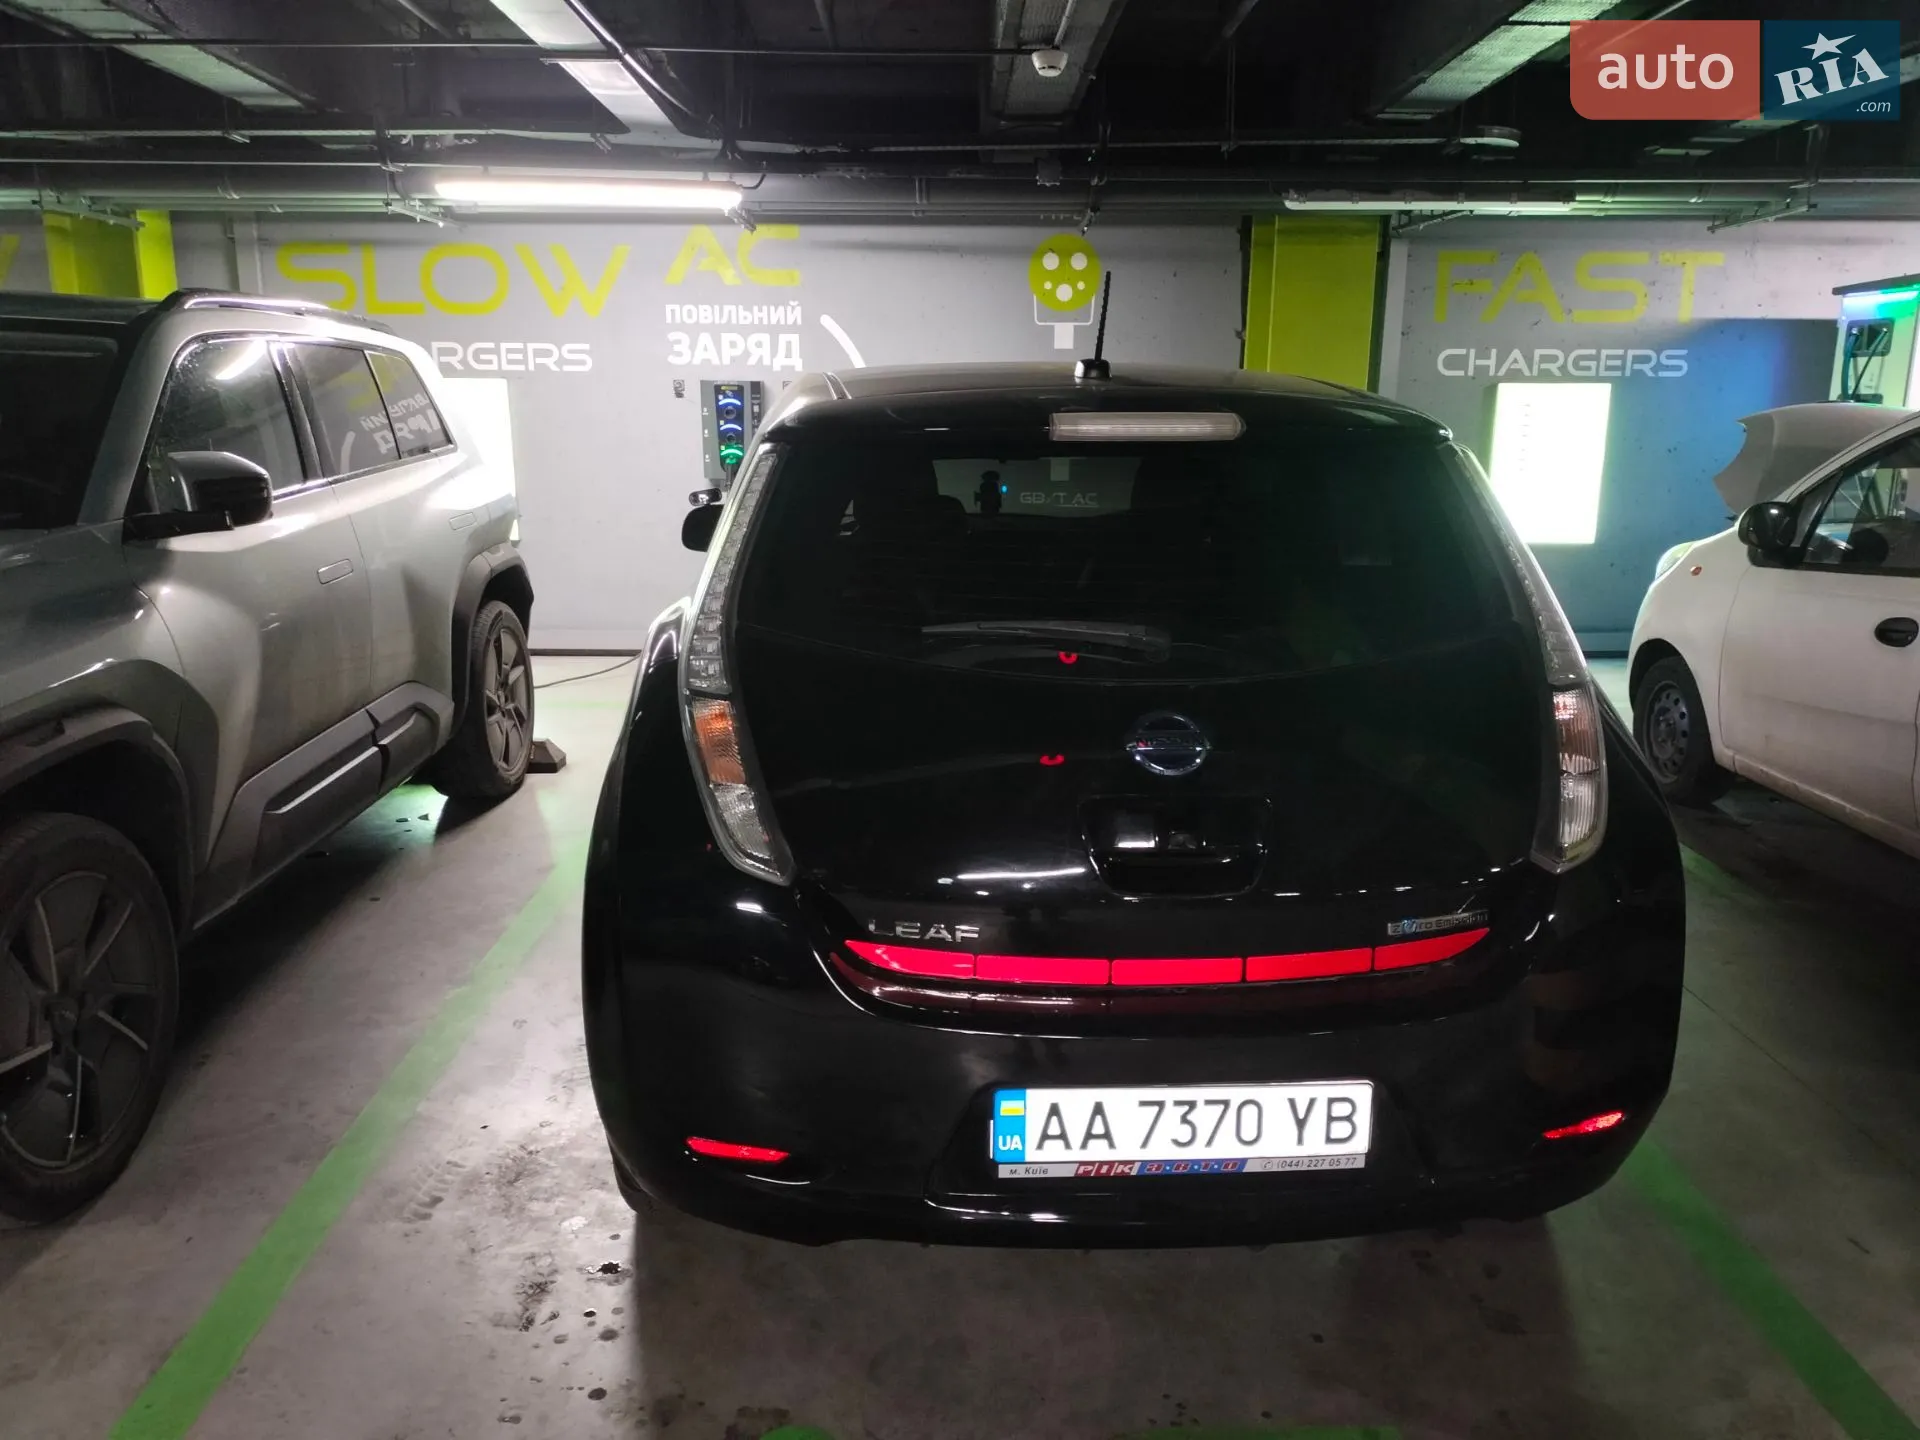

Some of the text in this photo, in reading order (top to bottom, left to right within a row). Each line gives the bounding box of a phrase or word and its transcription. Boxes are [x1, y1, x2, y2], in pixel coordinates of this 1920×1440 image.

[665, 223, 802, 287] AC
[276, 242, 632, 319] SLOW
[1434, 249, 1725, 324] FAST
[665, 300, 803, 326] ПОВІЛЬНИЙ
[430, 341, 593, 372] RGERS
[666, 331, 804, 372] ЗАРЯД
[1436, 347, 1690, 378] CHARGERS
[868, 919, 980, 942] LEAF
[1035, 1096, 1359, 1152] AA 7370 YB
[998, 1135, 1023, 1152] UA
[1276, 1159, 1304, 1169] (044)
[1306, 1158, 1326, 1168] 227
[1328, 1157, 1342, 1167] 05
[1344, 1157, 1357, 1166] 77
